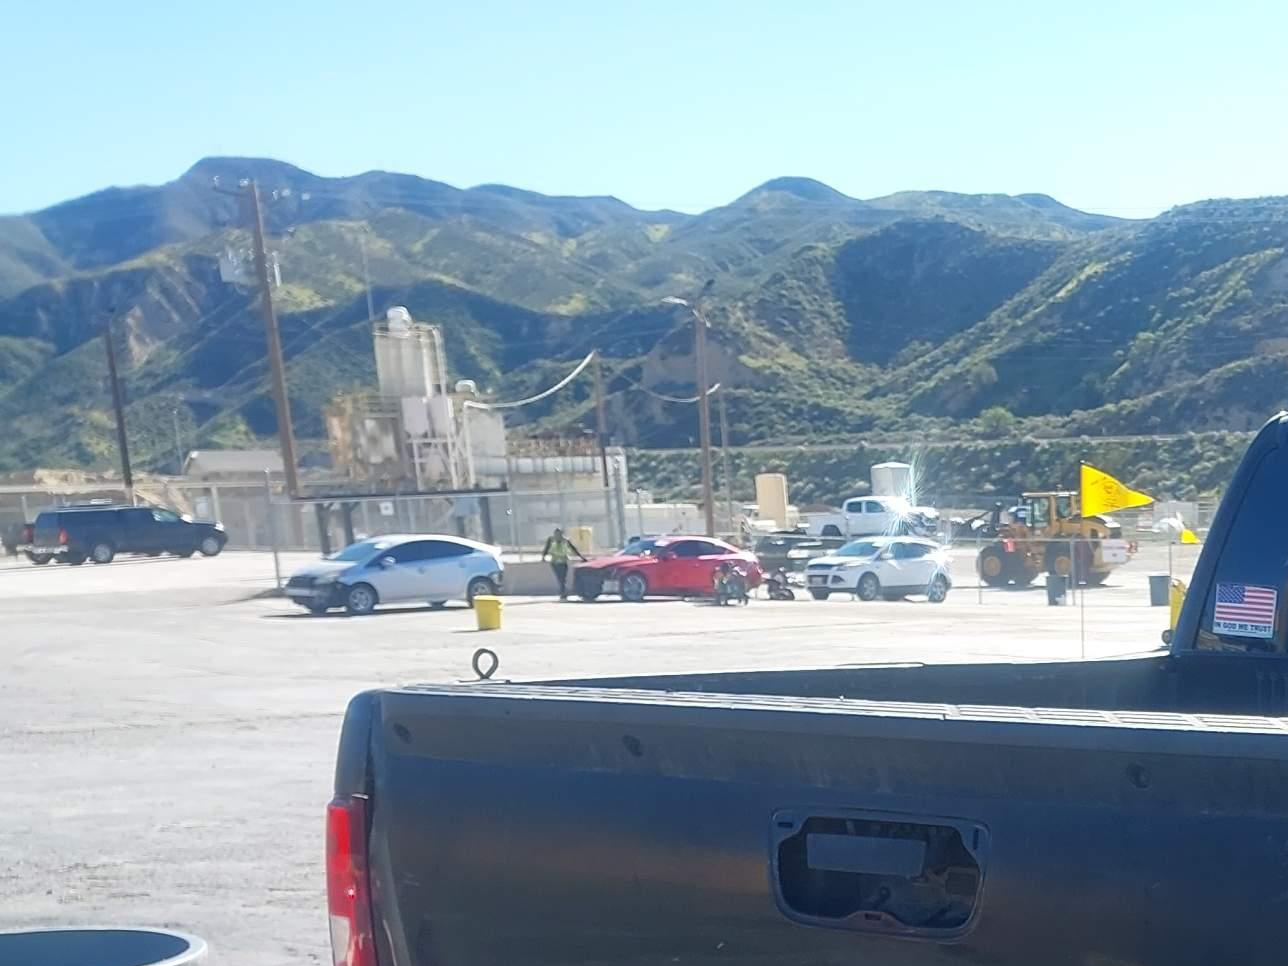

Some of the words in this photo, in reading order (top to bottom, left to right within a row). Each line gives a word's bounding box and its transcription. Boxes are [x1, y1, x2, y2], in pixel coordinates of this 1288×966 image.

[1222, 622, 1236, 630] GOD
[1238, 623, 1249, 631] WE
[1250, 624, 1272, 633] TRUST
